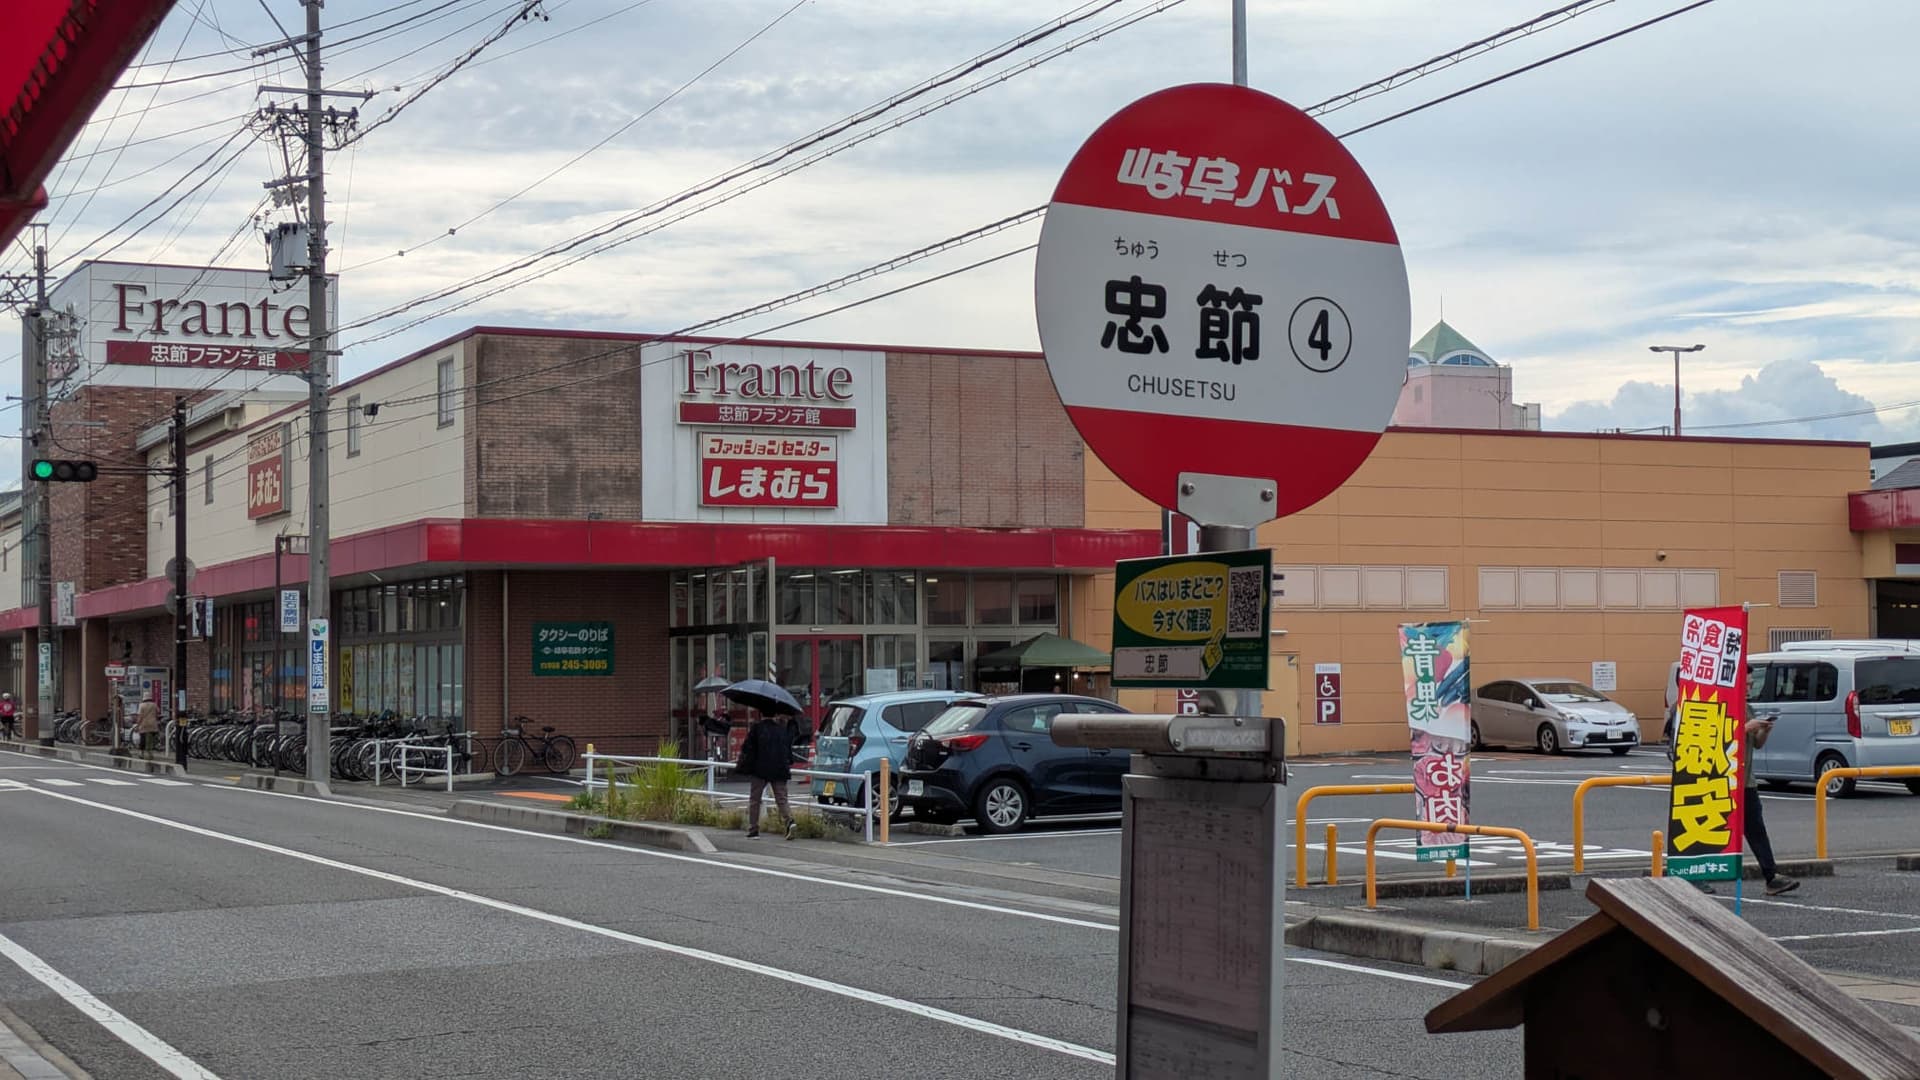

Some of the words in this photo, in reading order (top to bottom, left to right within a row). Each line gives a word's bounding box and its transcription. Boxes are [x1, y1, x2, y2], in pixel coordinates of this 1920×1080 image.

[1117, 147, 1341, 220] 岐阜バス
[1114, 236, 1160, 260] ちゅう
[1213, 249, 1248, 268] せつ
[112, 283, 311, 340] Frante
[1101, 274, 1264, 366] 忠節
[150, 345, 277, 368] 忠節フランテ館
[680, 349, 855, 401] Frante
[1127, 374, 1237, 402] CHUSETSU
[718, 405, 821, 425] 忠節フランテ館
[708, 438, 831, 456] ファッションセンター
[249, 463, 281, 509] しまむら
[708, 465, 831, 500] しまむら
[1135, 575, 1225, 602] バスはいまどこ?
[1153, 608, 1212, 633] 今すぐ確認
[538, 628, 609, 641] タクシーのりば
[1144, 654, 1169, 674] 忠節
[1321, 700, 1336, 722] P
